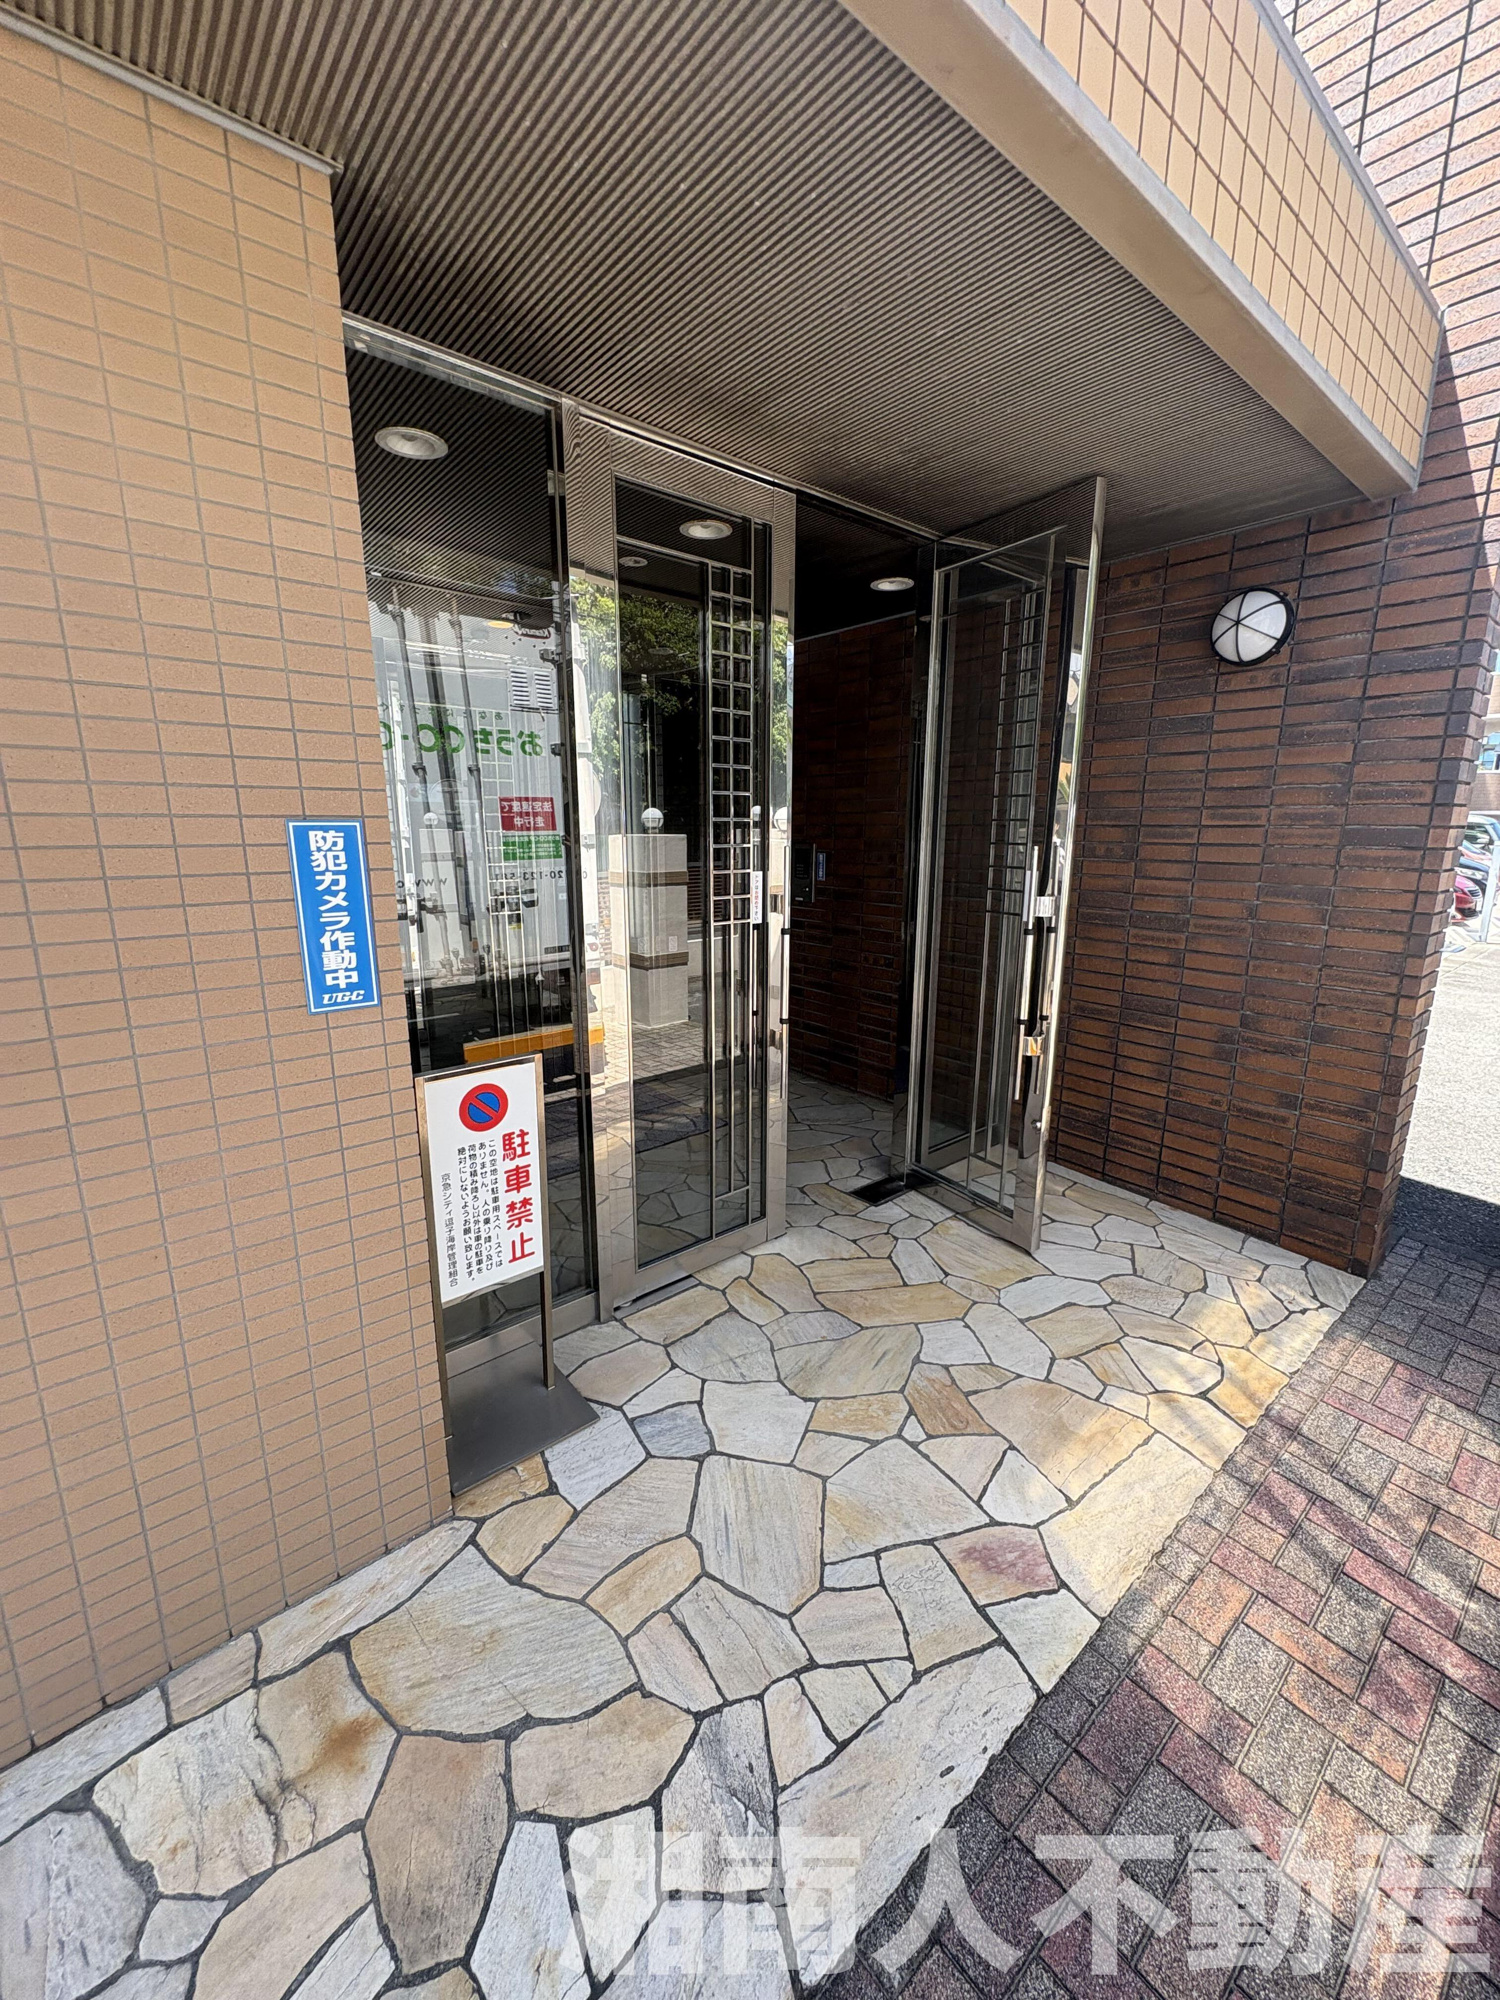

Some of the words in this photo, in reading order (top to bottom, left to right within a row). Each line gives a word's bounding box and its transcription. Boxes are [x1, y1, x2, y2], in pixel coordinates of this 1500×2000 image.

[308, 829, 359, 989] 防犯カメラ作動中
[321, 990, 365, 1005] UGC
[441, 1172, 458, 1287] 京急シティ逗子海岸管理組合
[457, 1147, 476, 1282] 絶対にしないようお願い致します。
[467, 1143, 484, 1275] 荷物の積み降ろし以外は車の駐車を
[488, 1139, 504, 1268] この空地は駐車用スペースでは
[501, 1128, 536, 1265] 駐車禁止
